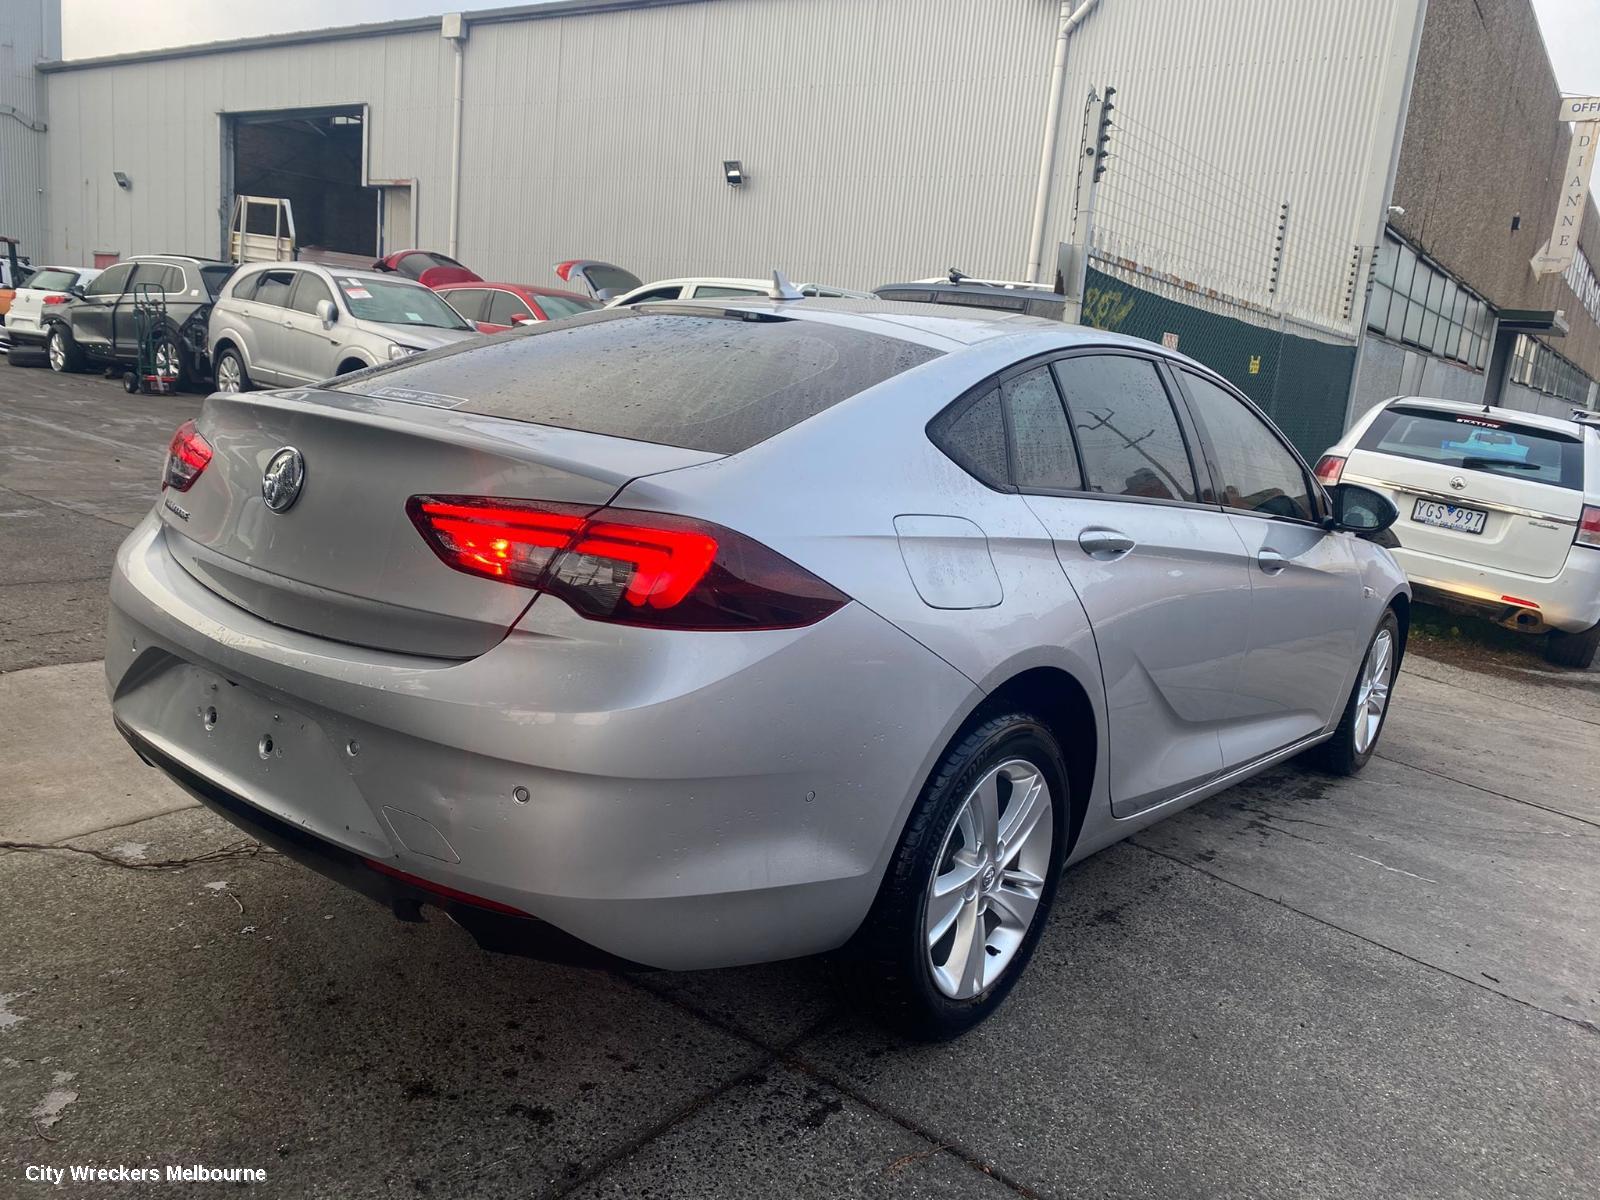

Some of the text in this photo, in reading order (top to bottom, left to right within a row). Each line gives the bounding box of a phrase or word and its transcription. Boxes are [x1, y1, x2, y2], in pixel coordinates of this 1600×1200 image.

[1559, 135, 1590, 246] DIANNE
[1418, 502, 1444, 519] YGS
[1455, 510, 1483, 527] 997
